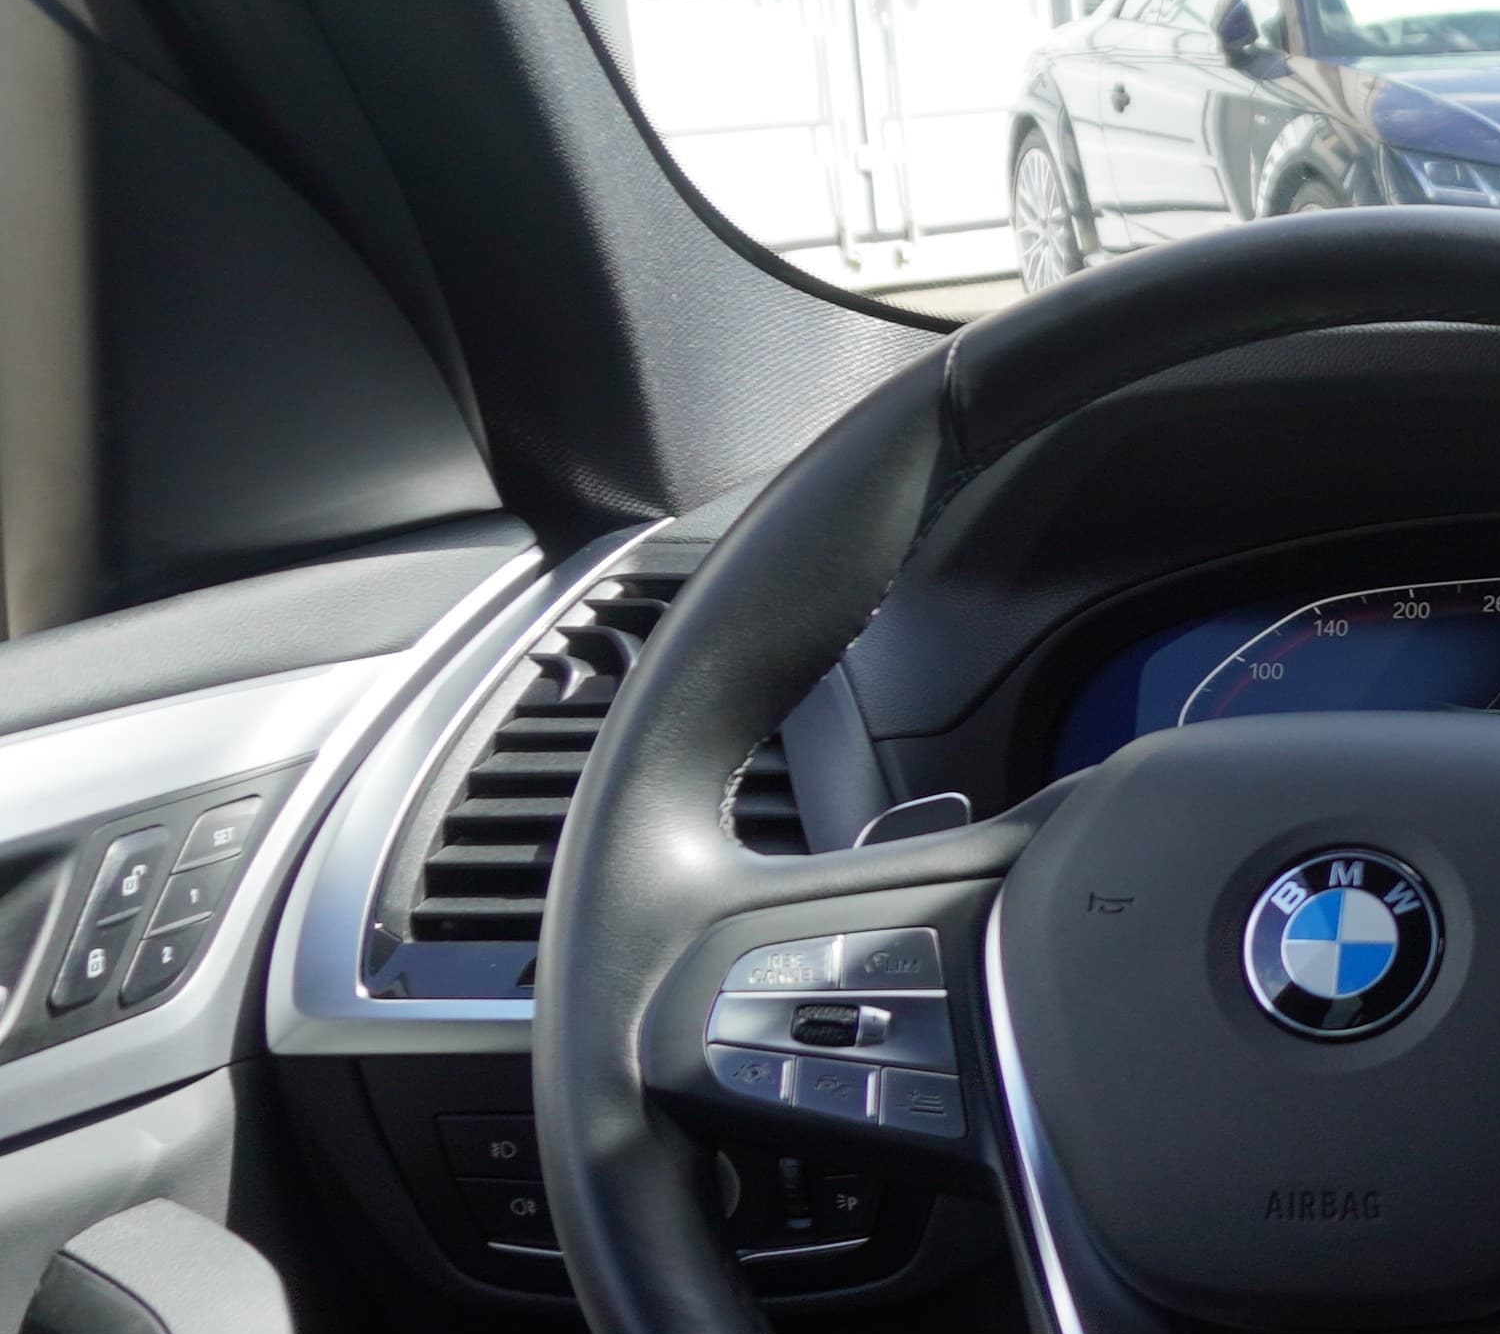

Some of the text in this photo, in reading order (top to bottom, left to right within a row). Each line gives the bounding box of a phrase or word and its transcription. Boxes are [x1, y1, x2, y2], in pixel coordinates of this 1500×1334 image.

[1392, 601, 1431, 619] 200
[1313, 619, 1349, 637] 140
[1249, 662, 1284, 680] 100
[213, 826, 236, 847] SET
[190, 888, 200, 904] 1
[1271, 860, 1421, 916] BMW
[161, 946, 173, 963] 2
[1264, 1189, 1382, 1221] AIRBAG
